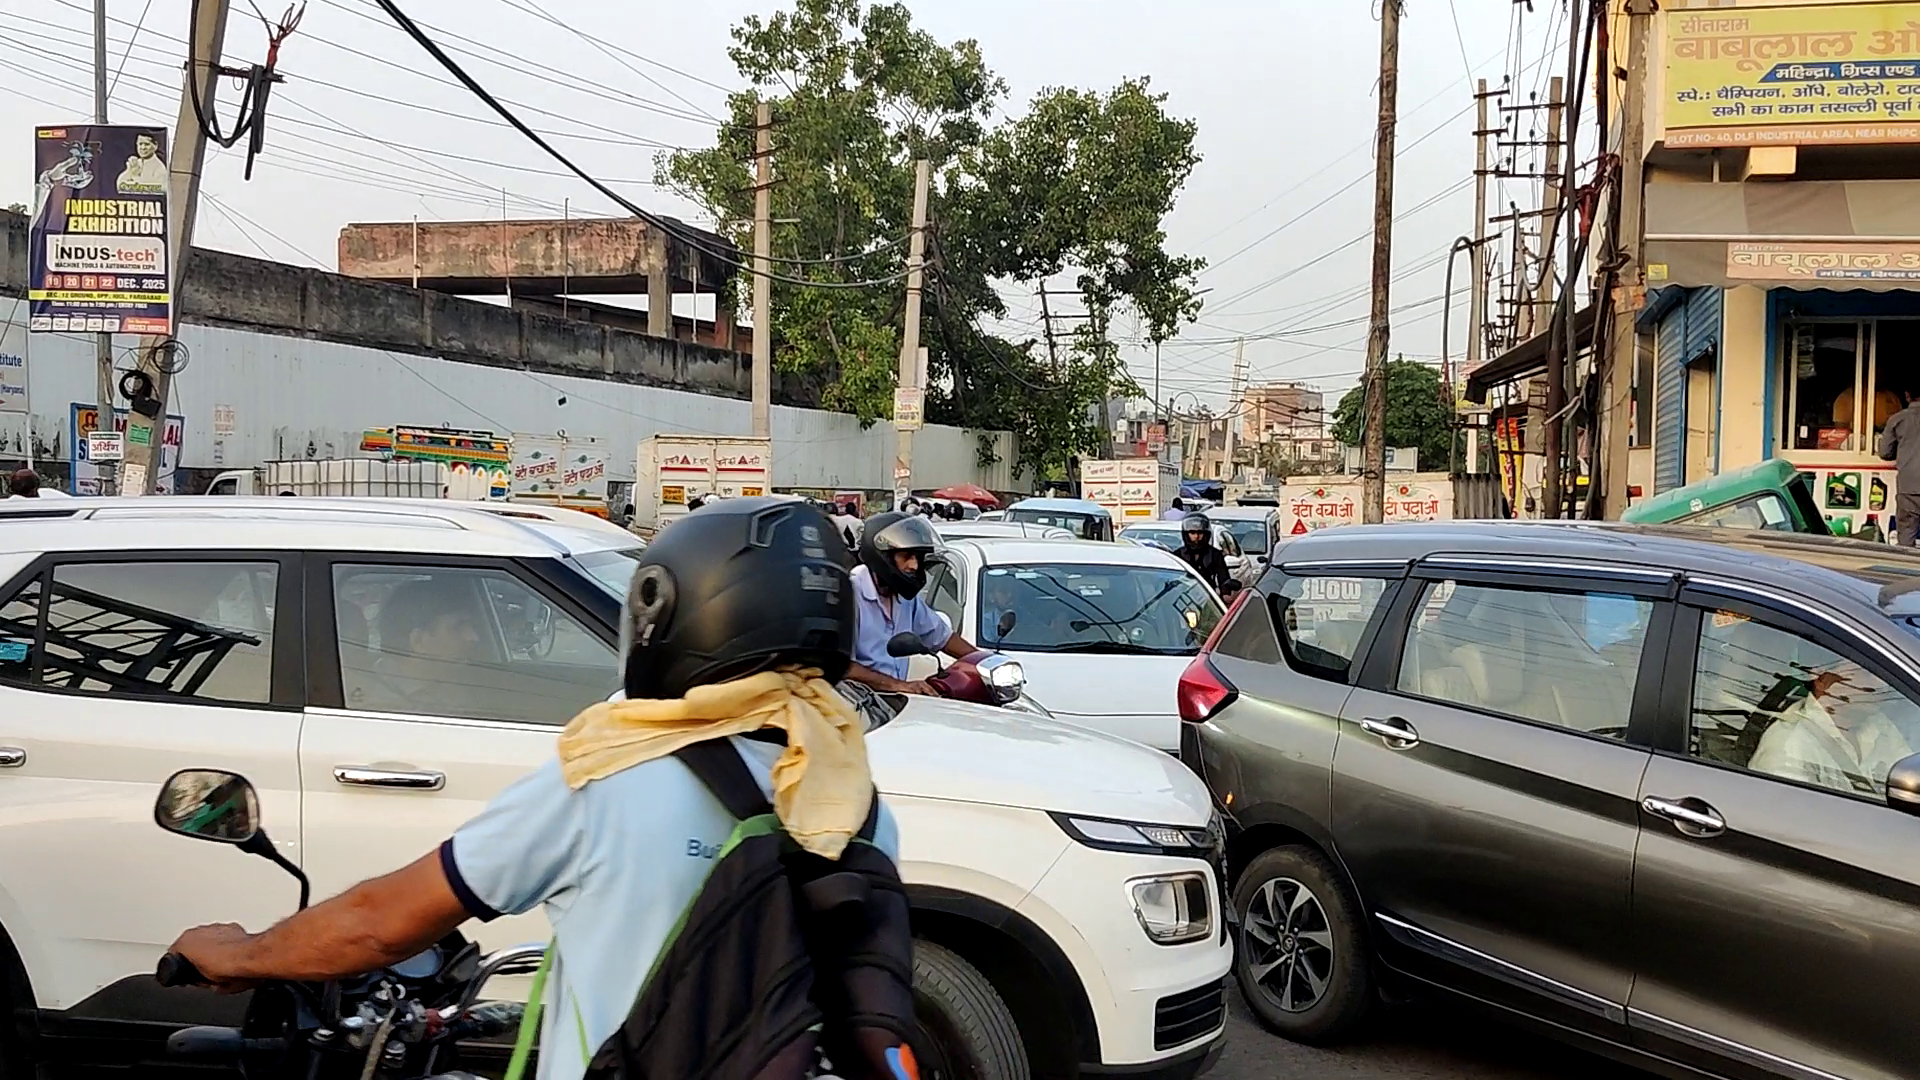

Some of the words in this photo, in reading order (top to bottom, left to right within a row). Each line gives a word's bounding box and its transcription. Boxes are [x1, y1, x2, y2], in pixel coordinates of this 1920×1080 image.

[1680, 16, 1749, 34] सीताराम
[1673, 31, 1857, 72] बाबूलाल
[1884, 65, 1916, 76] एण्ड
[1712, 102, 1745, 116] सभी
[1751, 105, 1773, 114] का
[1778, 103, 1814, 114] काम
[1819, 98, 1877, 113] तसल्ली
[1668, 134, 1693, 144] PLOT
[1756, 129, 1819, 141] INDUSTRIAL
[1856, 129, 1884, 138] NEAR
[65, 199, 164, 217] INDUSTRIAL
[67, 217, 164, 234] EXHIBITION
[1732, 250, 1894, 275] बाबूलाल
[66, 277, 77, 286] 20
[85, 278, 95, 286] 21
[101, 279, 113, 287] 22
[116, 278, 140, 289] DEC.
[142, 279, 165, 290] 2025
